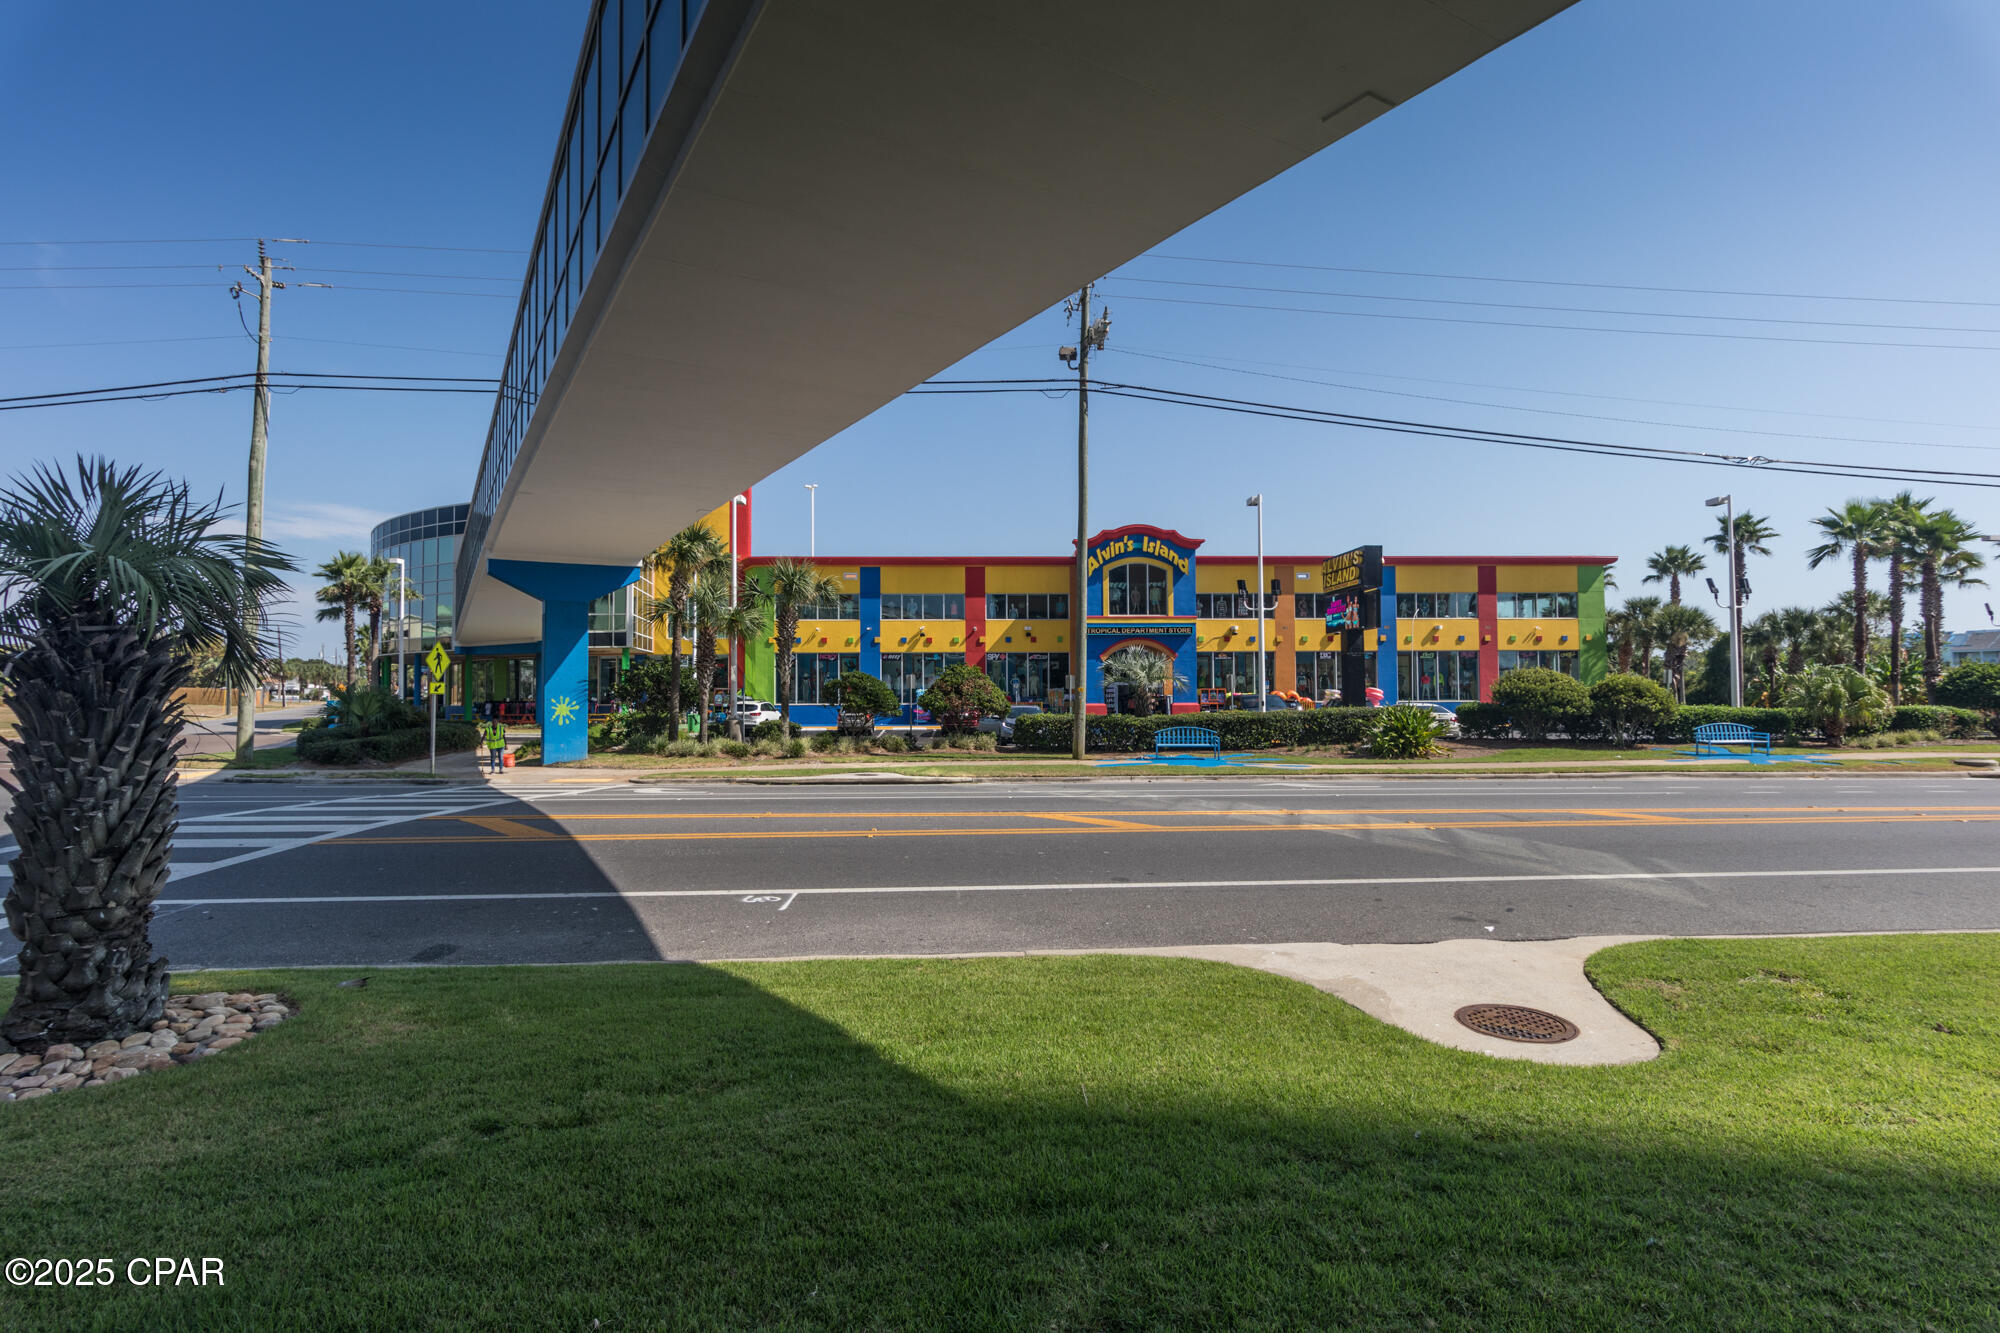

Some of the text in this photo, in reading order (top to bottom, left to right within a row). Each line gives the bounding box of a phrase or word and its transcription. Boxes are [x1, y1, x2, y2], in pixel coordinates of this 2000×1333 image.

[1087, 535, 1189, 577] Alvin's Island
[1322, 550, 1363, 573] ALVIN'S
[1323, 566, 1359, 589] ISLAND
[986, 653, 1000, 661] SPY
